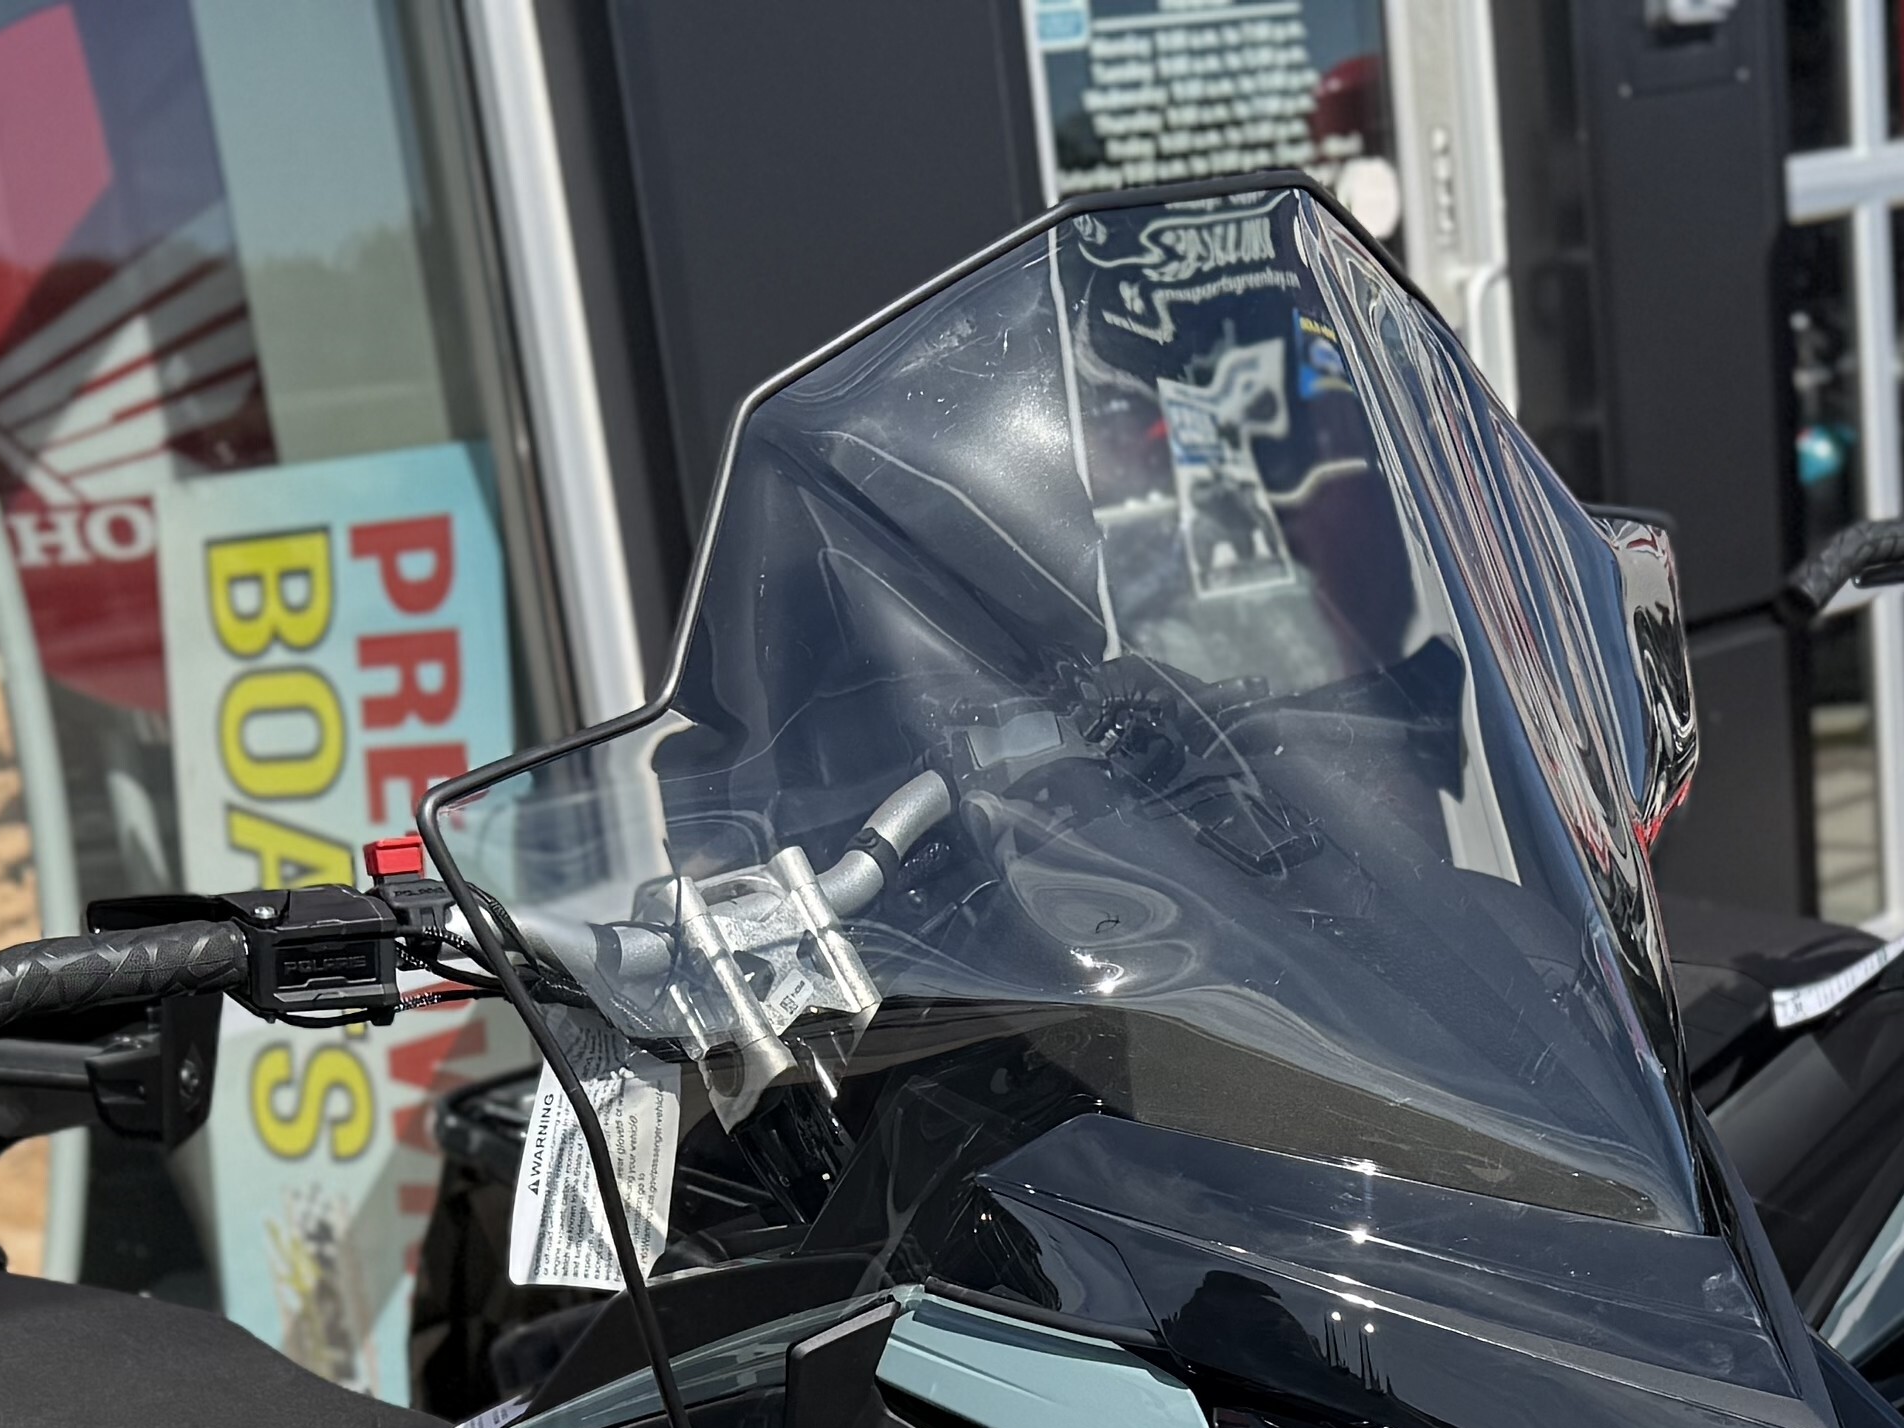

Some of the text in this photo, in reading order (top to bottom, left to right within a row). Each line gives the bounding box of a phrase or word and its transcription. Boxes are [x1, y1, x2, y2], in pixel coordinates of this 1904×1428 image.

[205, 522, 378, 1163] BOAS
[282, 956, 367, 977] POLARIS
[530, 1093, 555, 1177] WARNING
